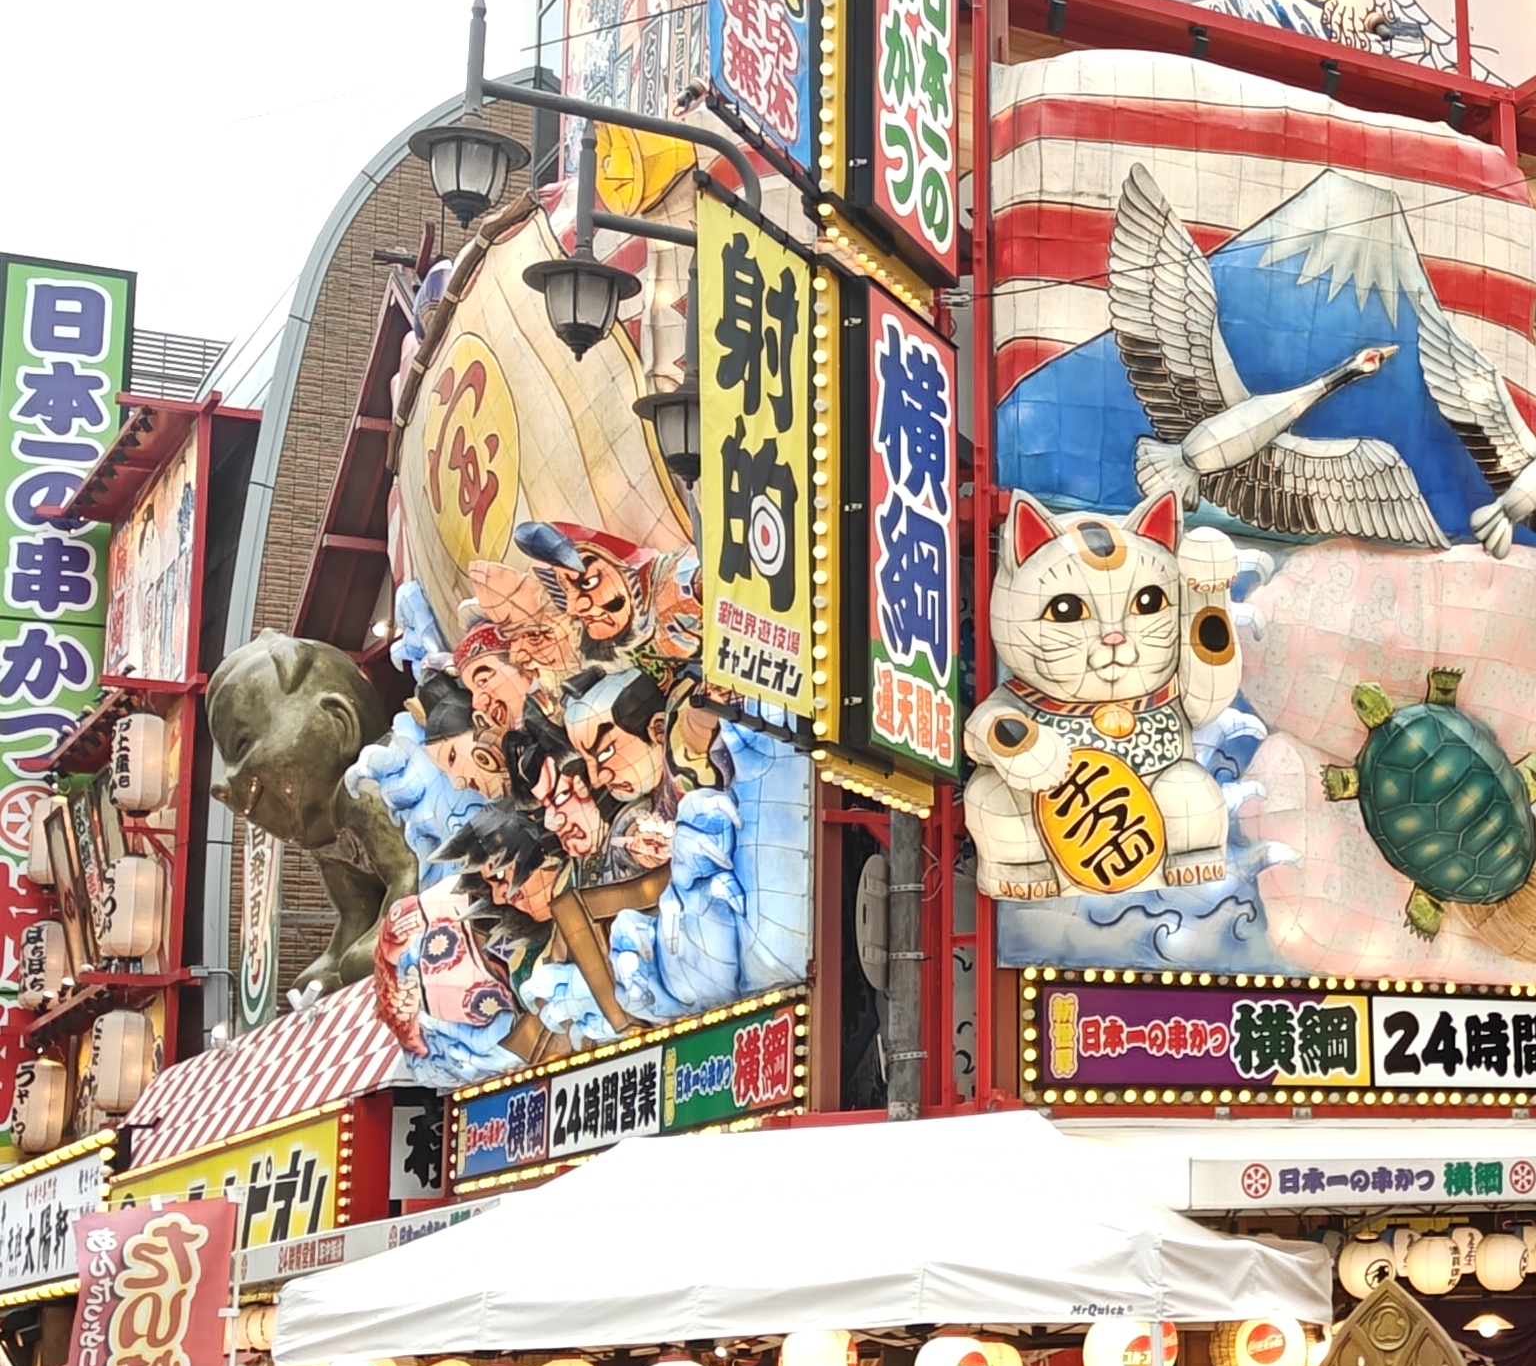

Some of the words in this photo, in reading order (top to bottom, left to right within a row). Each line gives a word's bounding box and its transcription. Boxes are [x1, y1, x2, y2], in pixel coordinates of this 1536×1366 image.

[716, 232, 798, 612] 射的
[2, 283, 106, 767] 日本一の串かつ
[877, 325, 948, 678] 横綱
[717, 599, 801, 655] 新世界遊技場
[717, 636, 803, 699] チャンピオン
[875, 658, 954, 765] 通天閣店
[733, 1015, 794, 1106] 横綱
[1081, 1018, 1227, 1056] 日本一の串かつ
[1233, 1004, 1357, 1075] 横綱
[507, 1087, 548, 1162] 横綱
[553, 1061, 658, 1148] 24時間営業
[1279, 1168, 1435, 1194] 日本一の串かつ
[1444, 1162, 1503, 1195] 横綱
